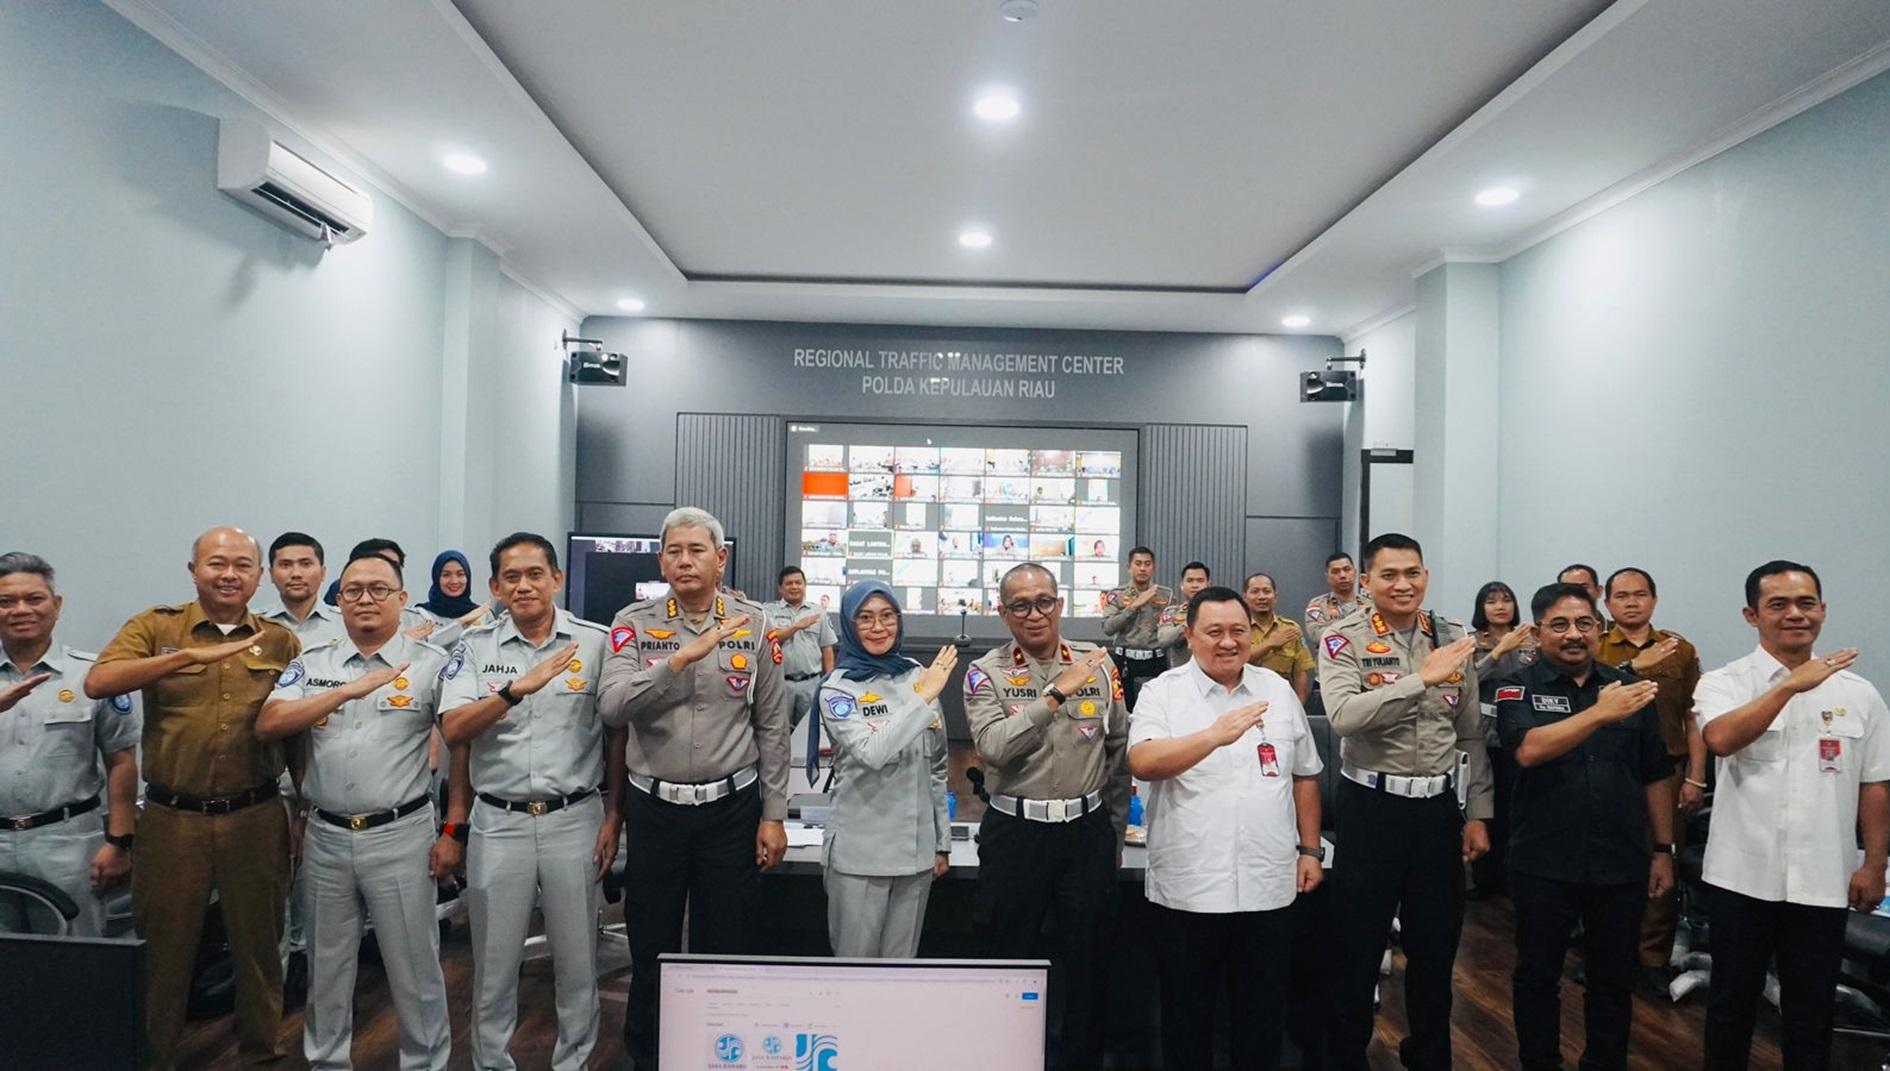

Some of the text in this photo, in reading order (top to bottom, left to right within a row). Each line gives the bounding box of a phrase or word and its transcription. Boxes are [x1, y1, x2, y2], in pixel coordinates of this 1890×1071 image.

[794, 349, 1124, 374] REGIONAL TRAFFIC MANAGEMENT CENTER
[862, 376, 1056, 398] POLDA KEPULAUAN RIAU
[640, 640, 680, 650] PRIANTO
[718, 640, 755, 650] POLRI
[482, 664, 518, 674] JAHJA
[1003, 687, 1037, 698] YUSRI
[863, 704, 889, 717] DEWI
